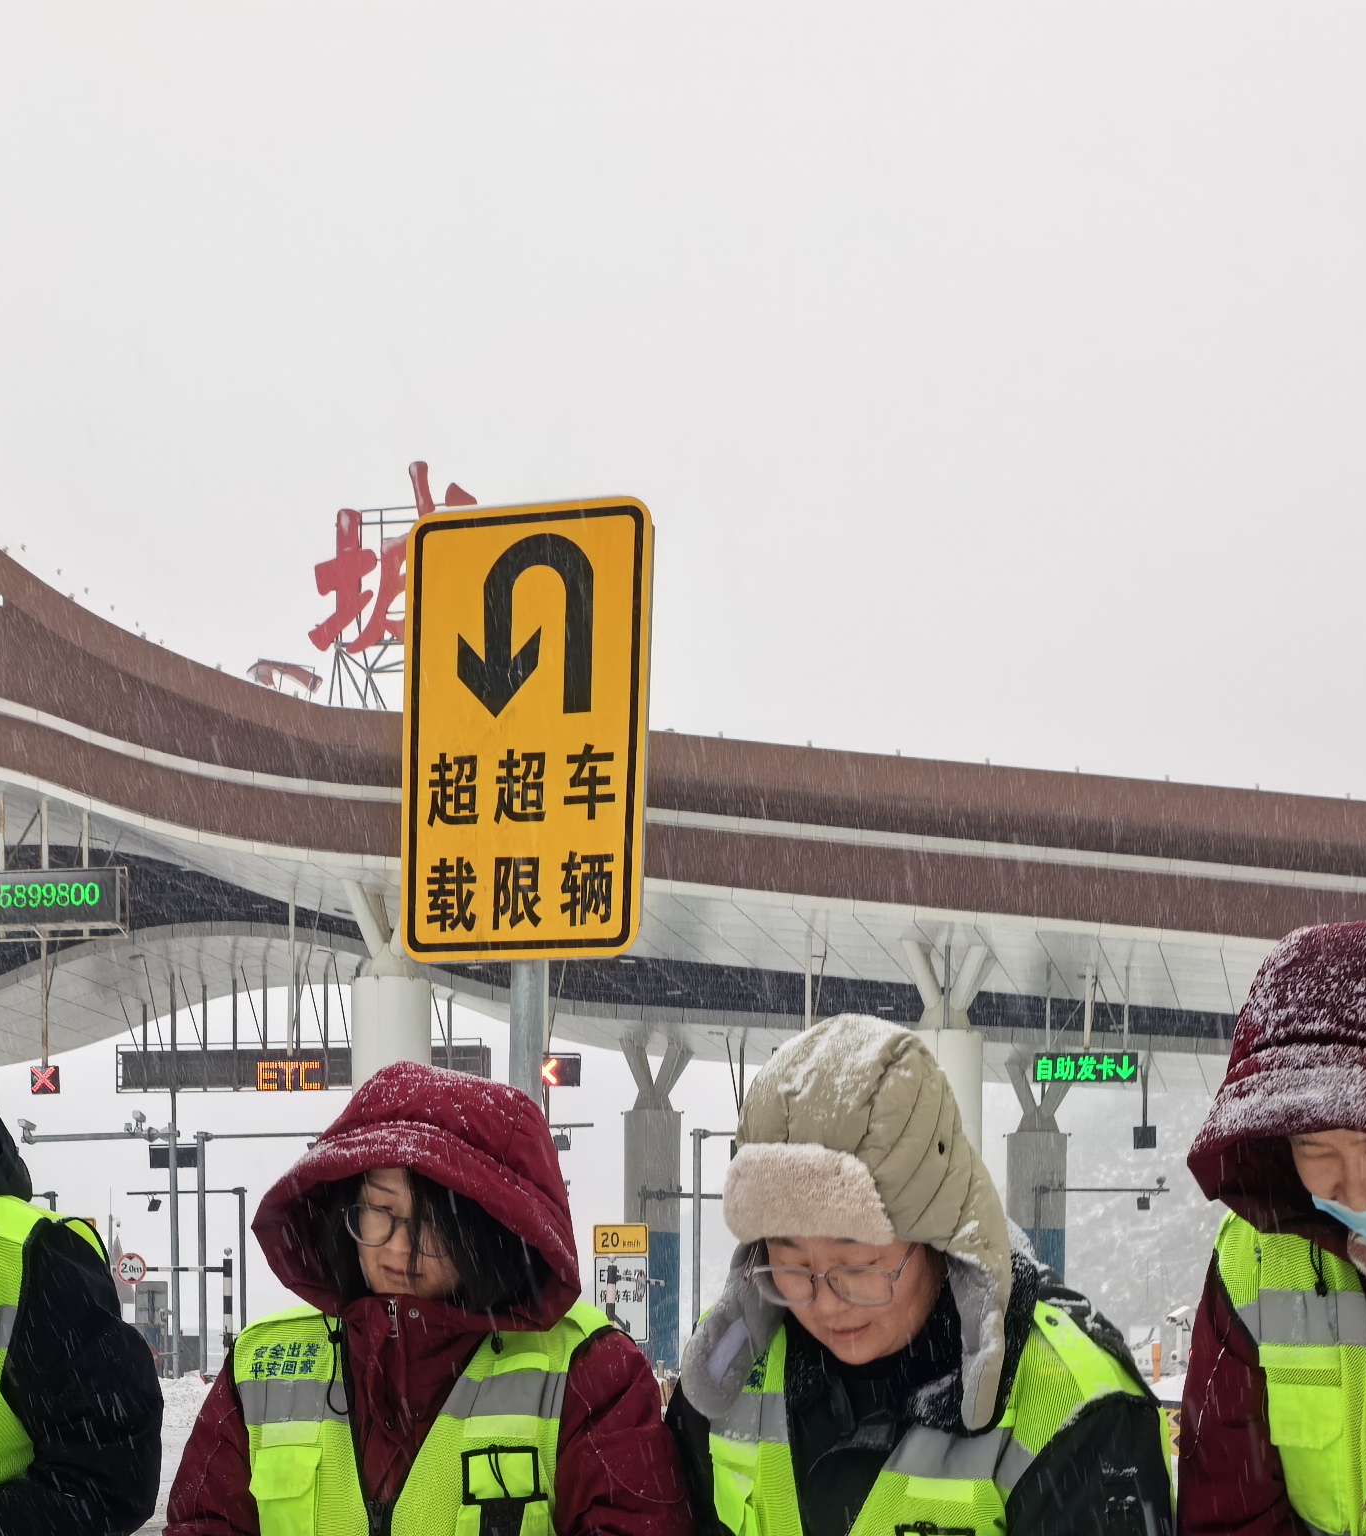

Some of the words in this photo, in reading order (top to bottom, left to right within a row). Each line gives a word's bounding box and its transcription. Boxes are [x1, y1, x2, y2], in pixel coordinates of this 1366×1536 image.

[256, 1061, 321, 1091] ETC
[1036, 1055, 1116, 1081] 自助发卡
[601, 1232, 620, 1248] 20
[622, 1240, 641, 1249] km/h
